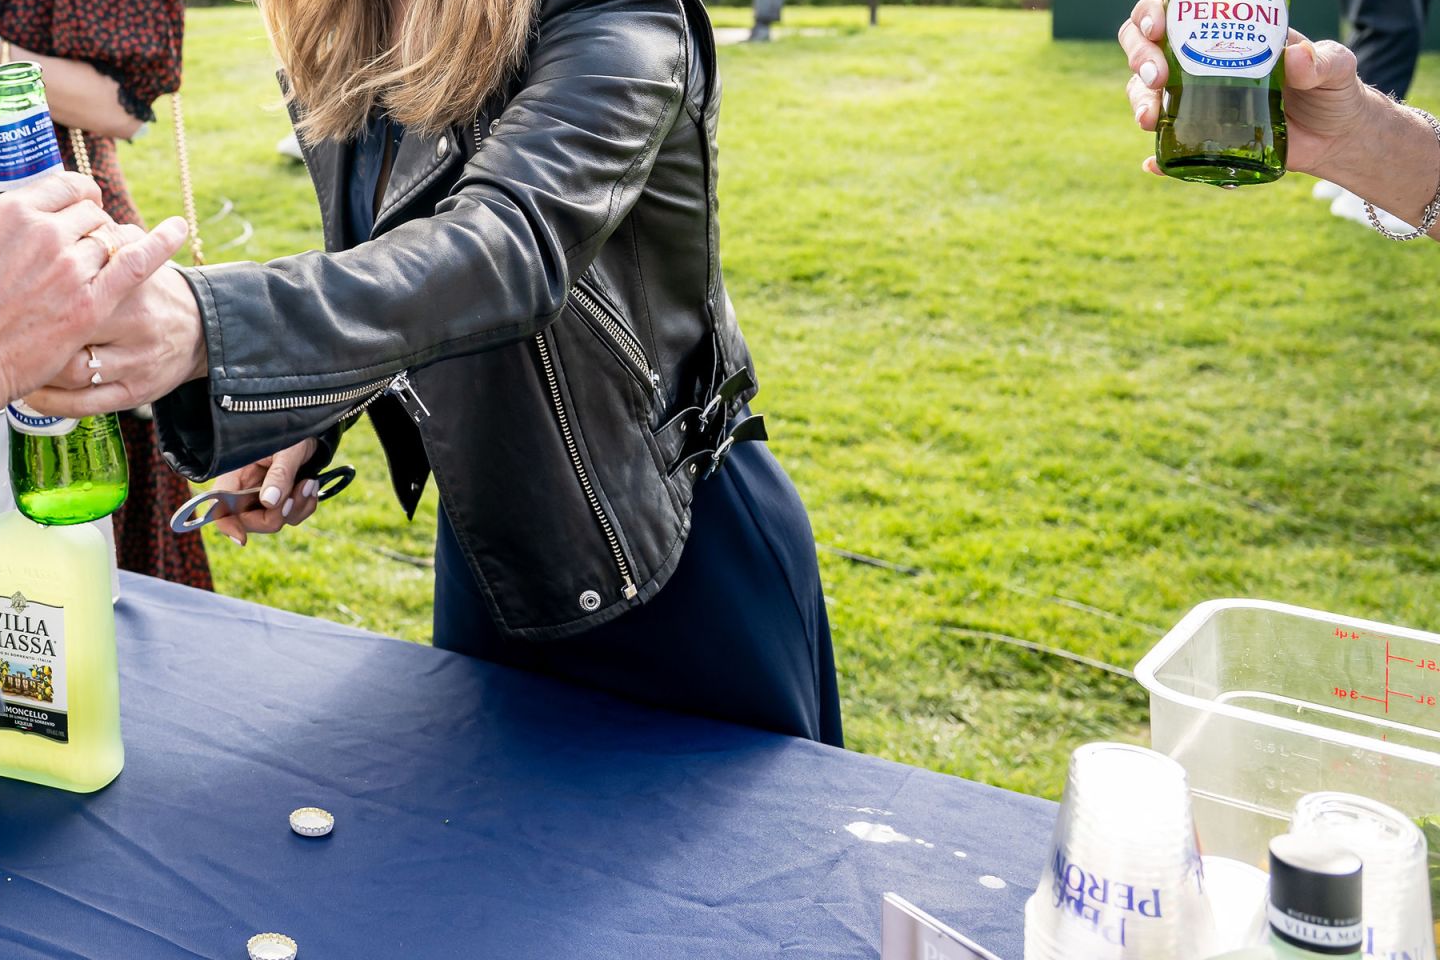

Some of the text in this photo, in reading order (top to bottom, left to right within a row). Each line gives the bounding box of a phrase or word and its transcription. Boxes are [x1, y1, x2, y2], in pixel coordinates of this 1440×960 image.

[1177, 0, 1279, 26] PERONI
[1201, 22, 1256, 32] NASTRO
[1189, 30, 1267, 43] AZZURRO
[1201, 56, 1253, 67] ITALIANA
[3, 705, 49, 721] IMONCELLO
[1284, 920, 1332, 942] VILLA
